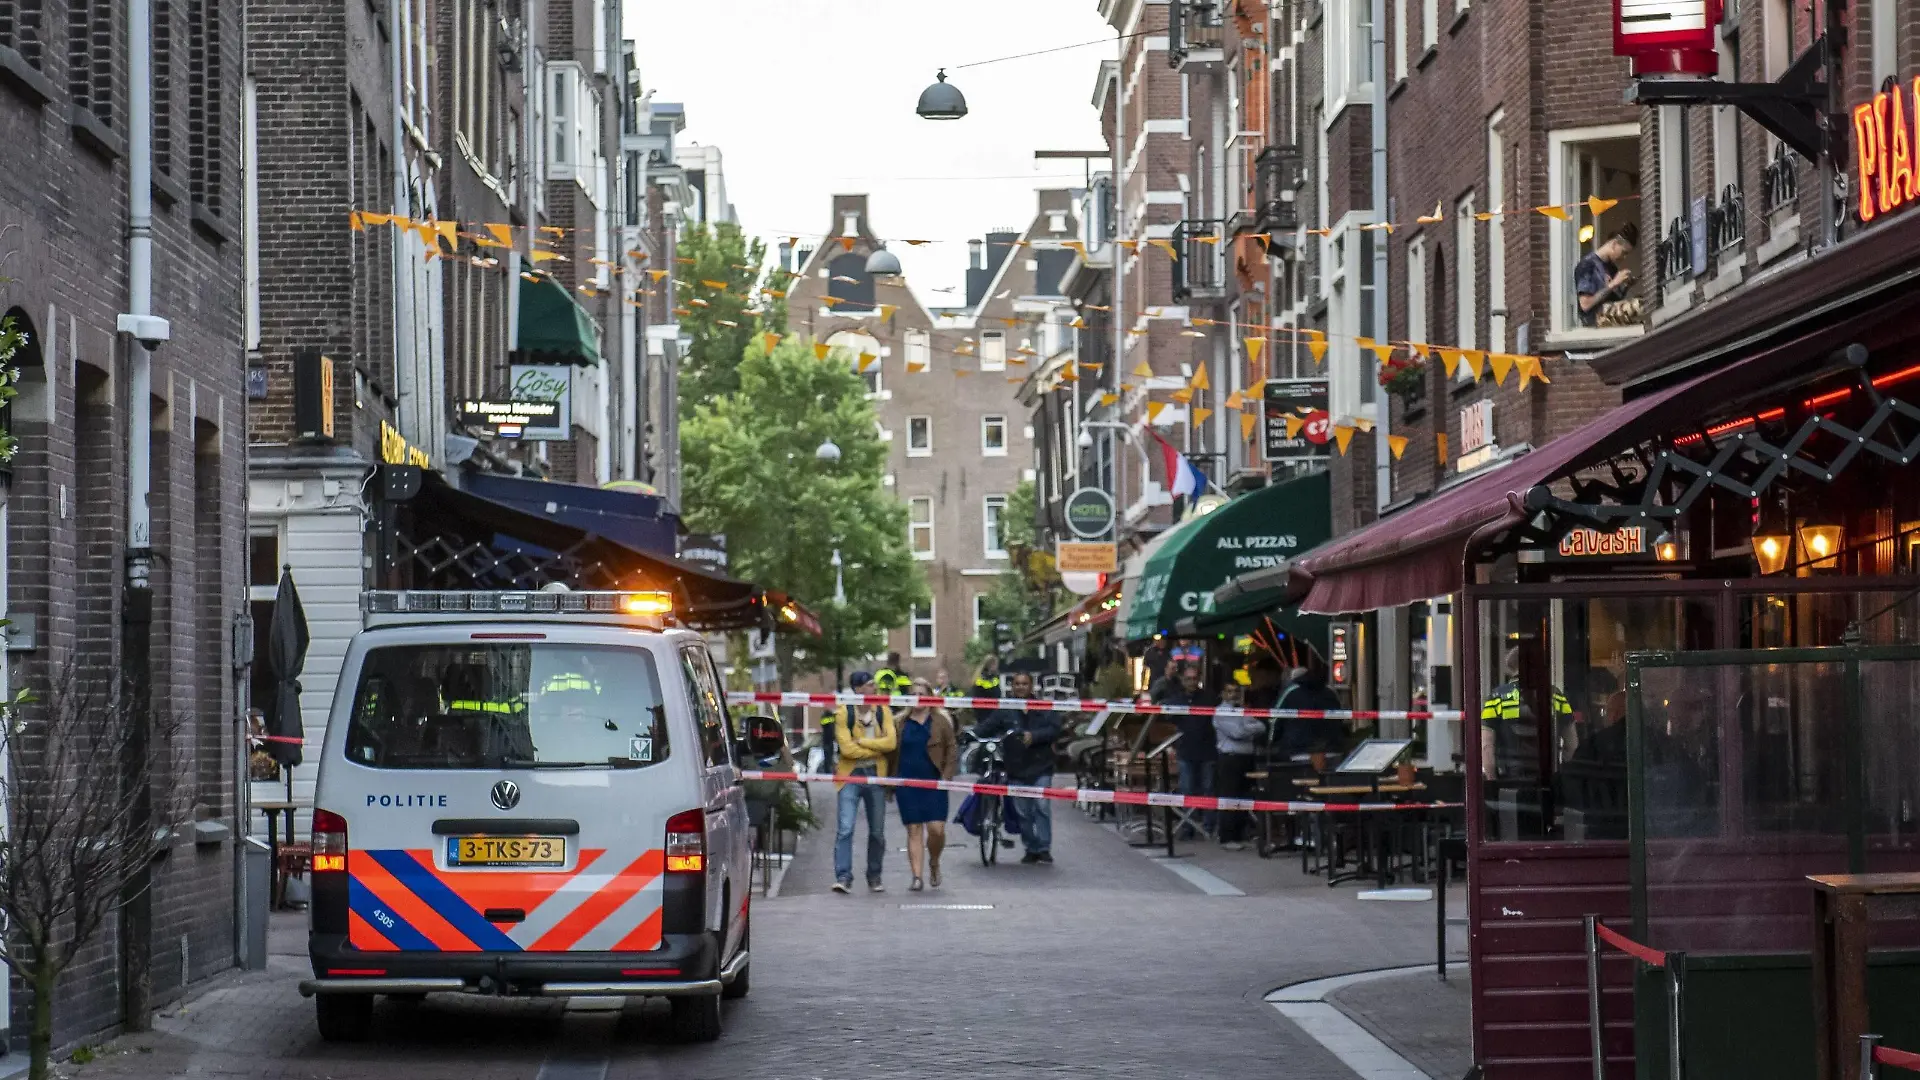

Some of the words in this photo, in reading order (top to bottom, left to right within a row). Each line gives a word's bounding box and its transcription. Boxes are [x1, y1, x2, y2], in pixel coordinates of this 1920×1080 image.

[1217, 537, 1242, 549] ALL
[1245, 535, 1298, 549] PIZZA'S
[366, 795, 448, 807] POLITIE
[465, 841, 552, 859] 3-TKS-73
[373, 909, 395, 928] 4305
